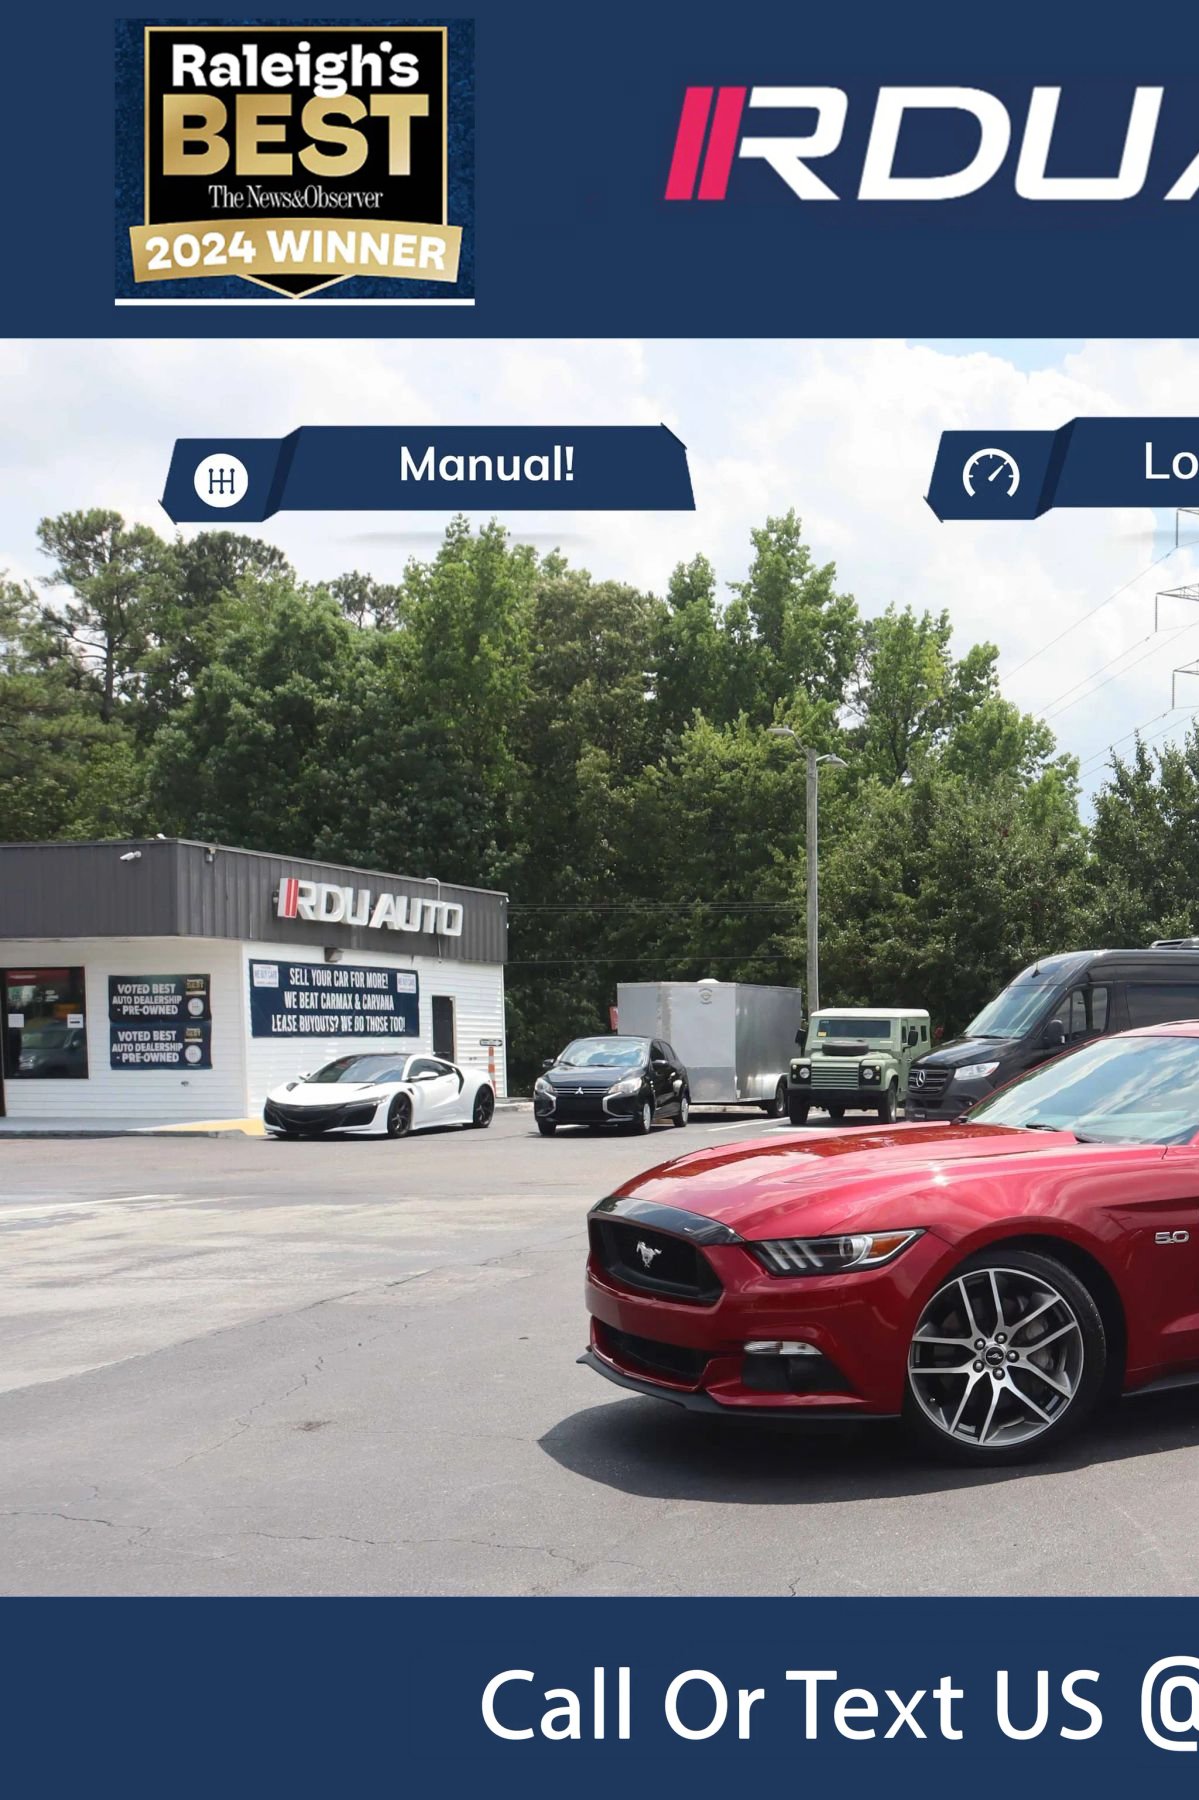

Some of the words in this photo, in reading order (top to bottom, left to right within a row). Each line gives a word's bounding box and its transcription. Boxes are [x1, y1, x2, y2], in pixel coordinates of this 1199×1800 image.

[289, 967, 309, 986] SELL
[311, 969, 332, 986] YOUR
[333, 970, 349, 988] CAR
[350, 971, 365, 988] FOR
[366, 972, 389, 989] MORE!
[117, 983, 150, 994] VOTED
[152, 983, 177, 994] BEST
[112, 995, 133, 1005] AUTO
[133, 995, 183, 1005] DEALERSHIP
[284, 991, 297, 1009] WE
[299, 991, 319, 1009] BEAT
[321, 992, 353, 1010] CARMAX
[354, 993, 361, 1010] &
[362, 994, 395, 1011] CARVANA
[122, 1005, 179, 1015] PRE-OWNED
[271, 1014, 298, 1032] LEASE
[299, 1015, 339, 1032] BUYOUTS?
[340, 1015, 353, 1032] WE
[354, 1016, 364, 1032] DO
[365, 1016, 389, 1032] THOSE
[390, 1016, 406, 1032] TOO!
[117, 1031, 151, 1042] VOTED
[152, 1031, 177, 1041] BEST
[112, 1043, 133, 1053] AUTO
[134, 1042, 183, 1052] DEALERSHIP
[121, 1052, 179, 1063] PRE-OWNED
[1154, 1230, 1190, 1245] 5.0
